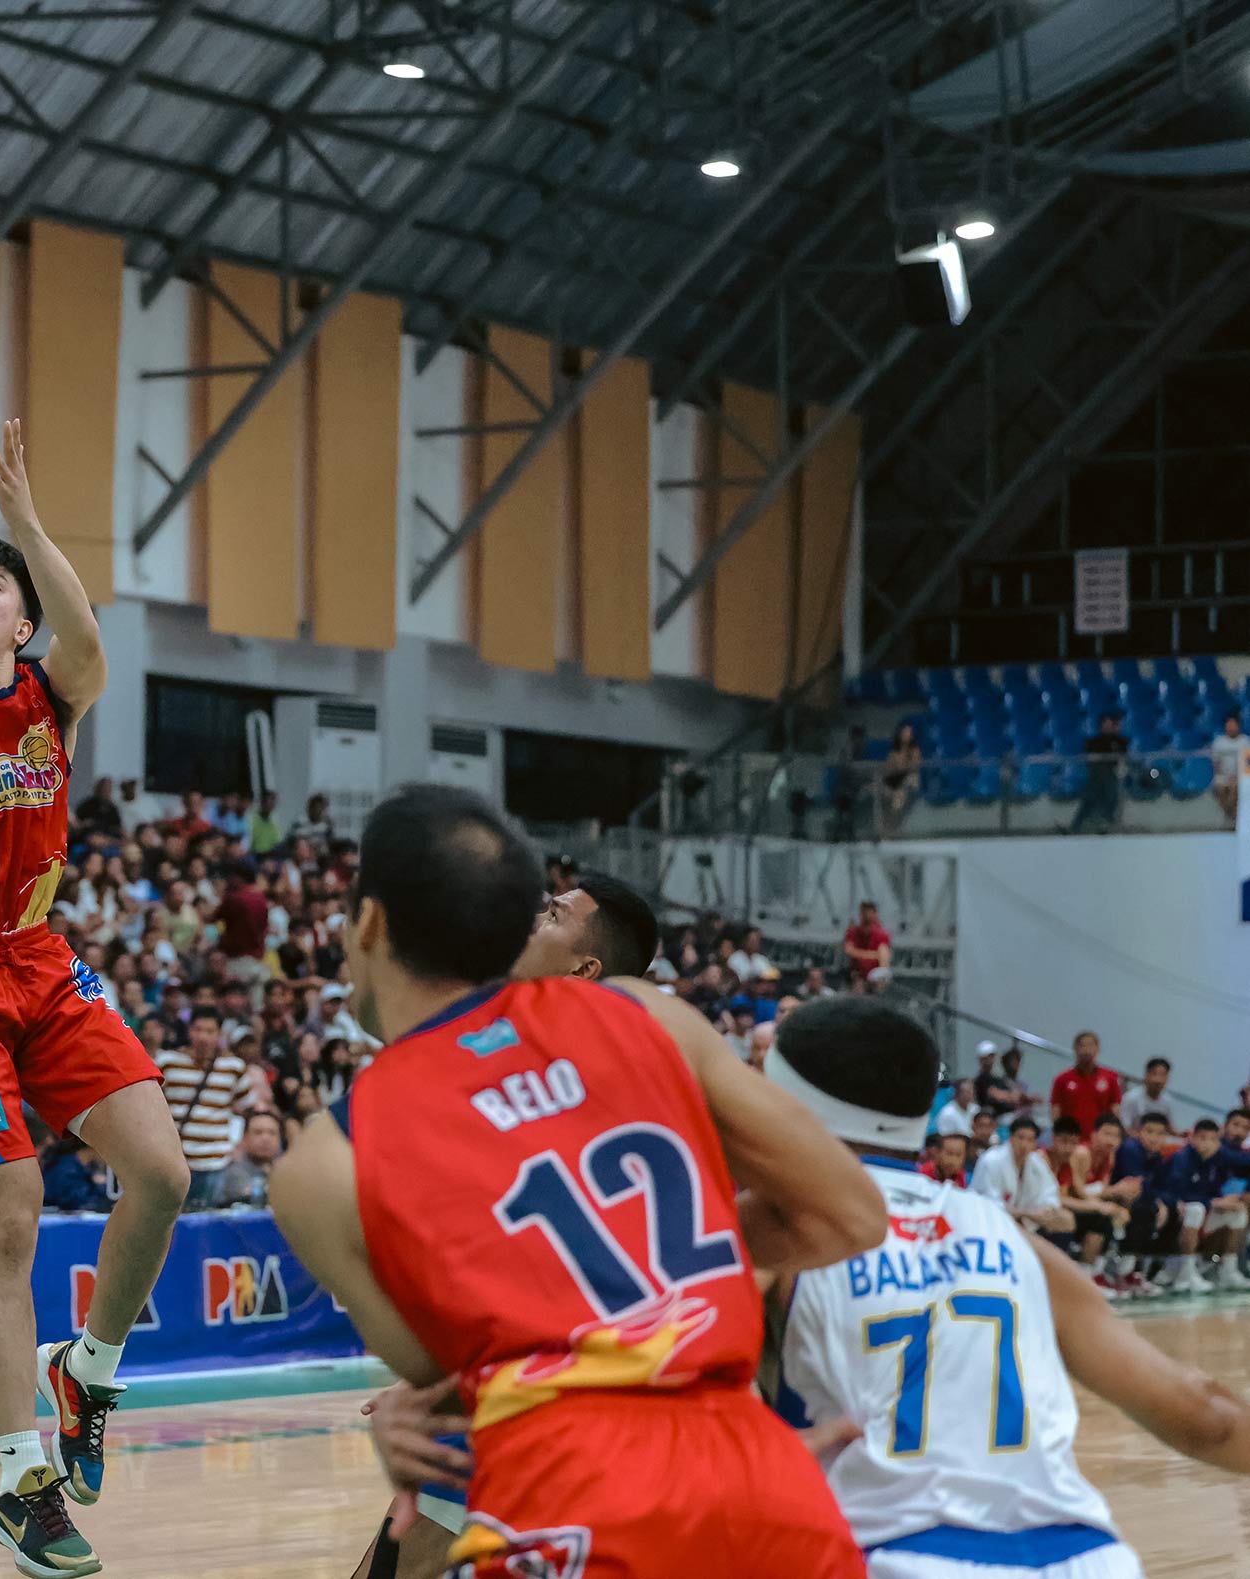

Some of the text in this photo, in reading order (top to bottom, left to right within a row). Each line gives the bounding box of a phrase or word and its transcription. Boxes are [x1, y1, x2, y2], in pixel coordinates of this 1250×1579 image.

[470, 1058, 586, 1132] BELO
[492, 1122, 743, 1325] 12
[203, 1255, 289, 1327] PBA
[862, 1289, 1031, 1460] 77
